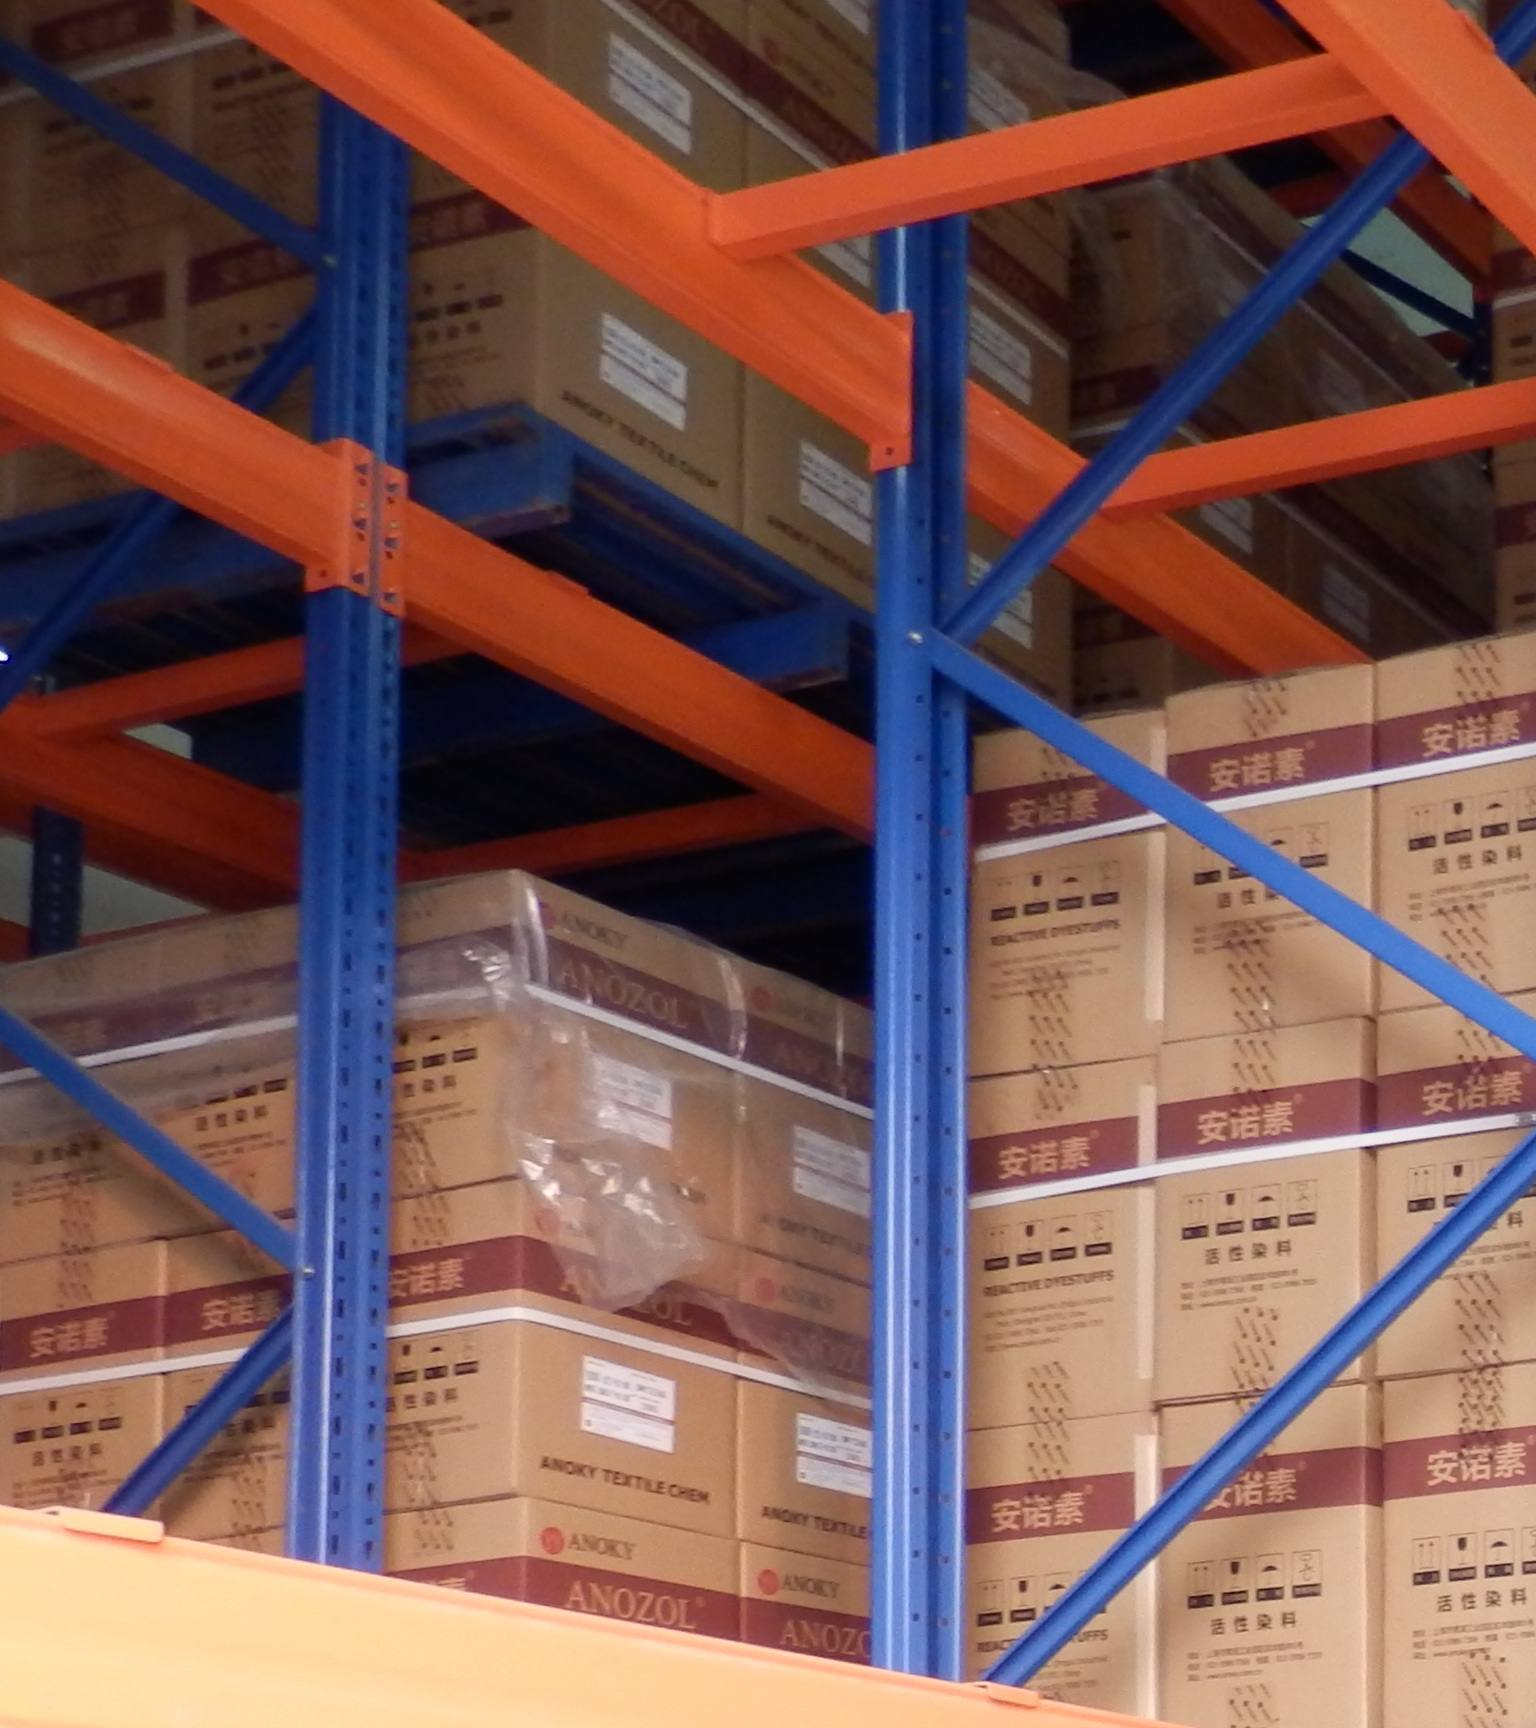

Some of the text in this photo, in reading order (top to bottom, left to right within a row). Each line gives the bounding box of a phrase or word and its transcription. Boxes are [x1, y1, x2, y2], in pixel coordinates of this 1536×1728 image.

[1422, 709, 1521, 758] 安诺素
[1208, 747, 1305, 793] 安诺素
[1007, 789, 1098, 834] 安诺素
[1423, 1068, 1522, 1116] 安诺素
[1197, 1101, 1294, 1145] 安诺素
[1000, 1138, 1090, 1180] 安诺素
[1204, 1239, 1292, 1267] 活性染料
[983, 1269, 1114, 1298] REACTIVE DYESTUFFS
[30, 1317, 110, 1358] 安诺素
[540, 1456, 710, 1504] ANOKY TEXTILE CHEM
[1427, 1442, 1528, 1488] 安诺素
[762, 1506, 867, 1540] ANOKY TEXTILE
[991, 1491, 1085, 1533] 安诺素
[568, 1533, 636, 1561] ANOKY
[566, 1578, 697, 1630] ANOZOL
[782, 1575, 840, 1599] ANOKY
[1436, 1587, 1528, 1615] 活性染料
[780, 1619, 872, 1658] ANOZO
[1210, 1610, 1297, 1637] 活性染料
